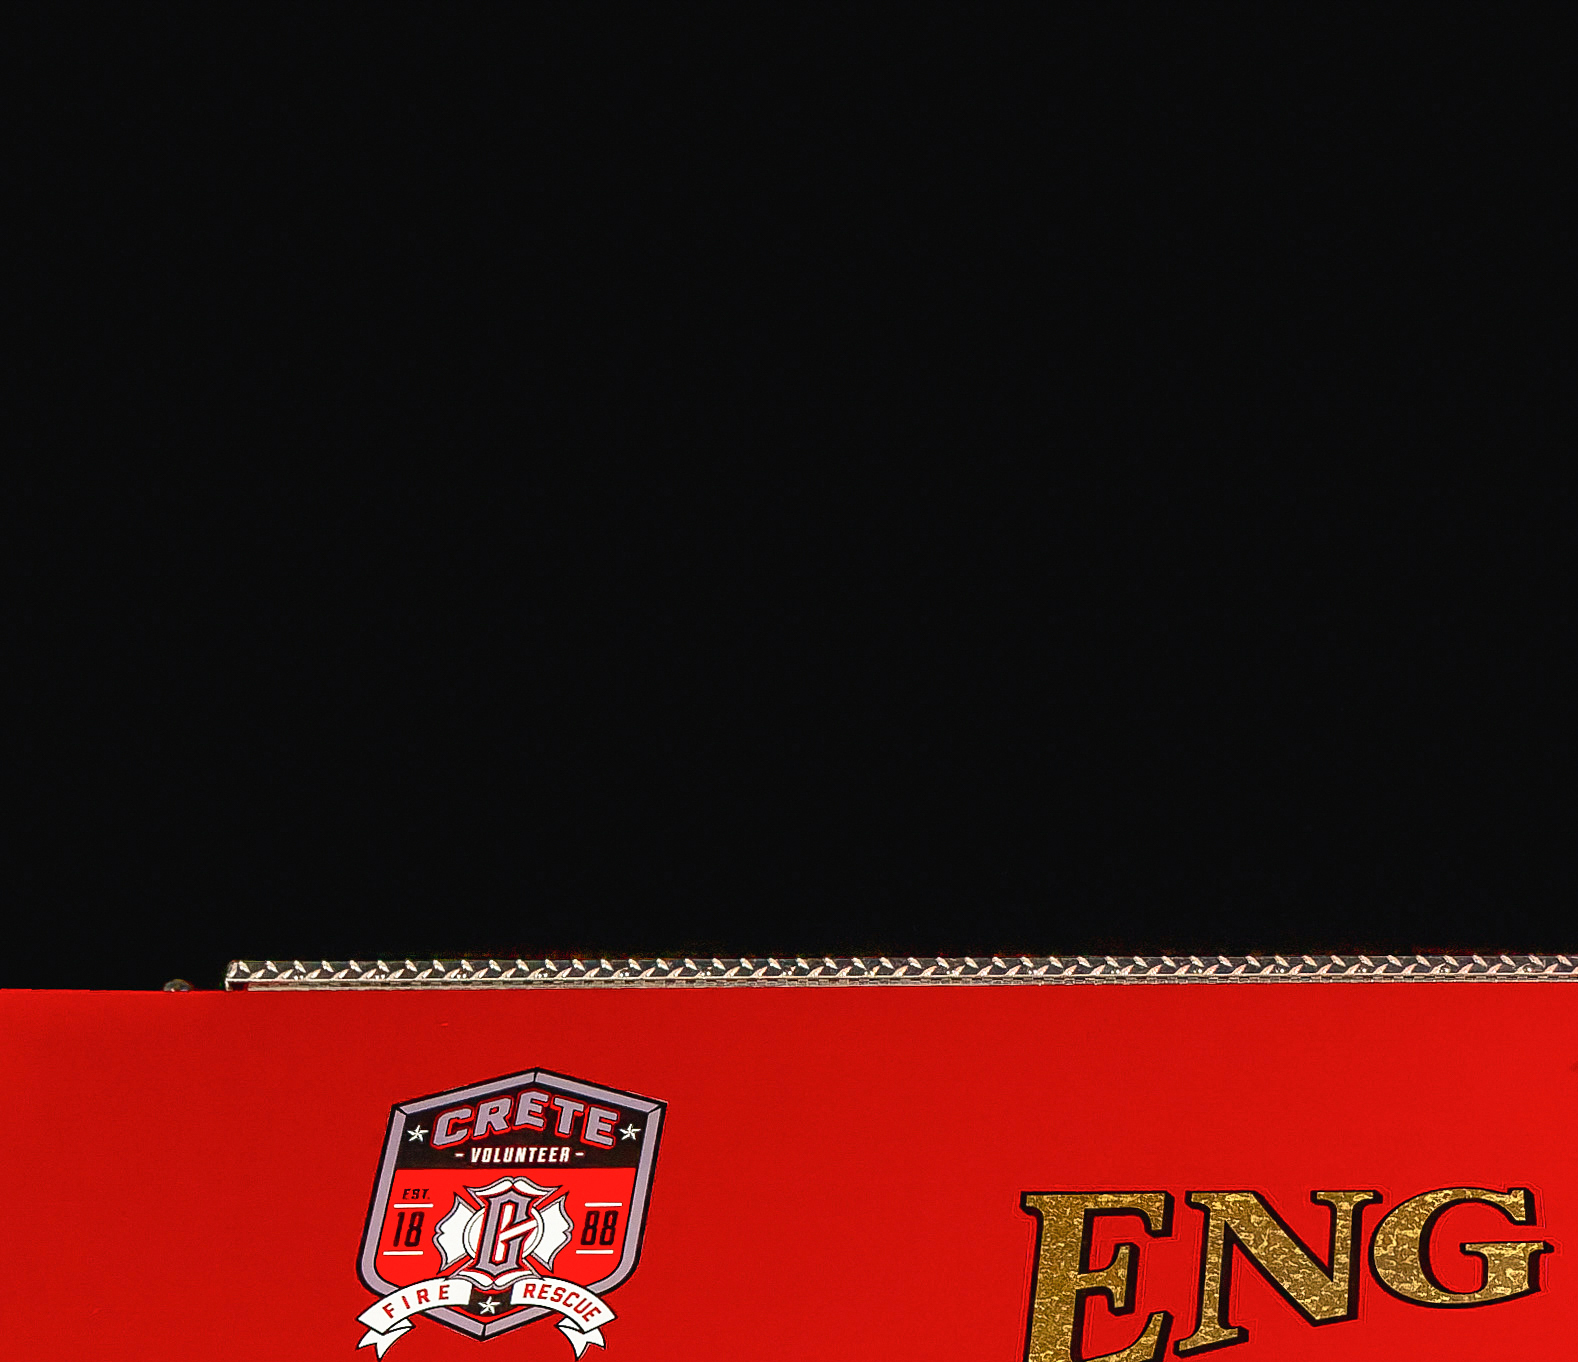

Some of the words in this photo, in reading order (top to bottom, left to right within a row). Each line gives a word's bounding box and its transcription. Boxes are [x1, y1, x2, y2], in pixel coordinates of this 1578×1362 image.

[431, 1090, 620, 1147] CRETE
[470, 1146, 571, 1164] VOLUNTEER
[401, 1188, 431, 1200] EST.
[392, 1211, 425, 1248] 18
[580, 1210, 619, 1246] 88
[382, 1283, 451, 1320] FIRE
[522, 1282, 602, 1323] RESCUE
